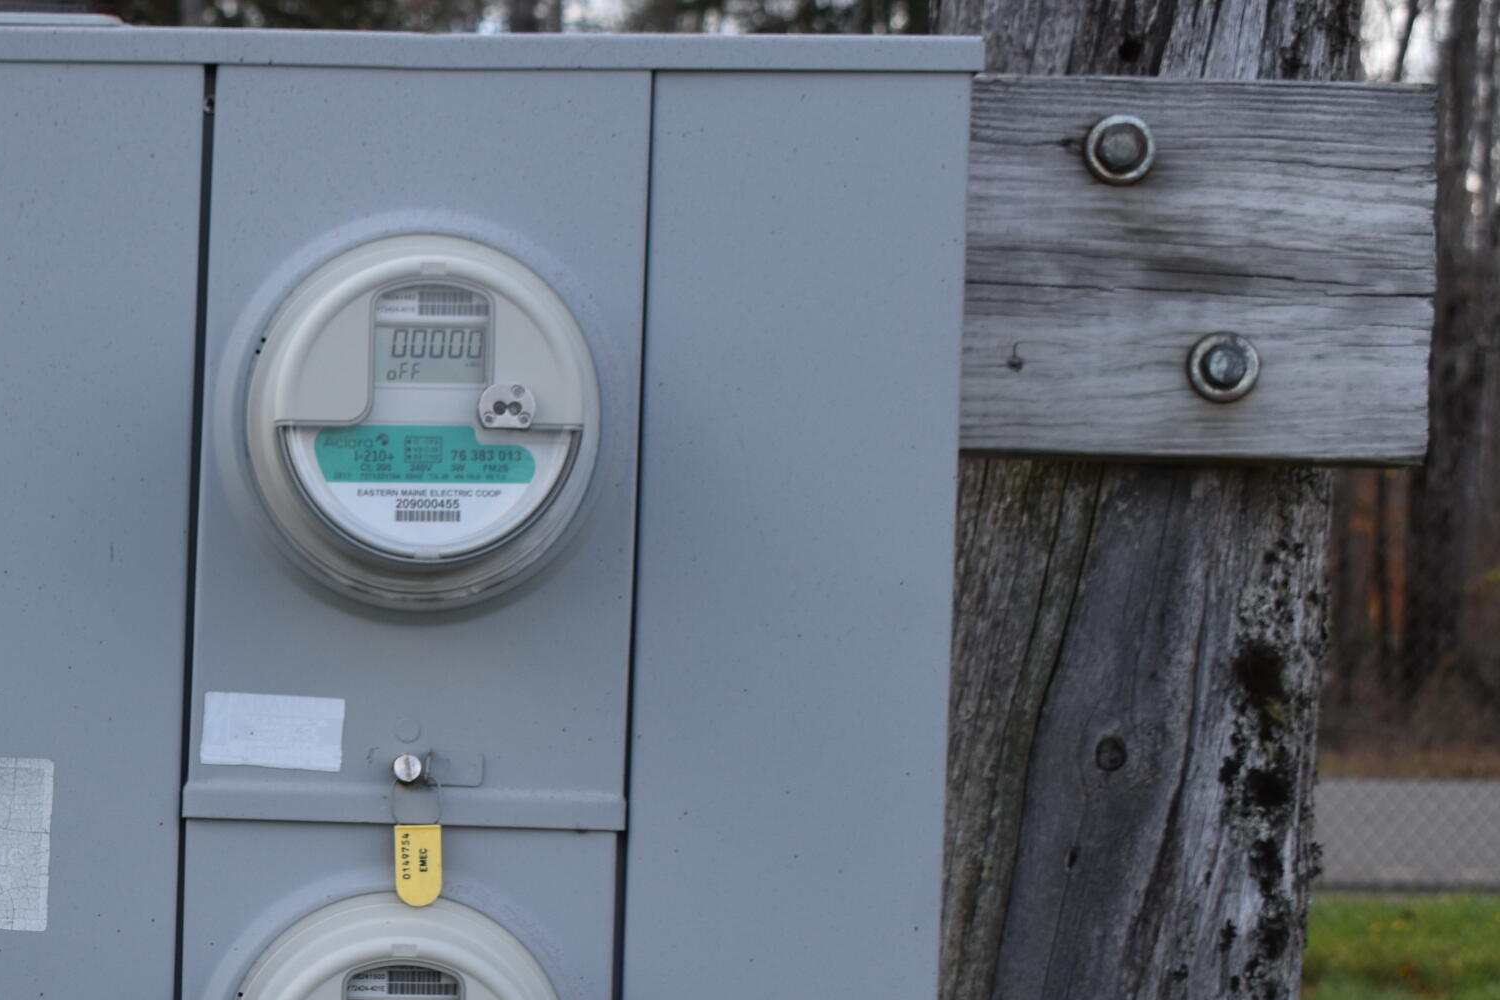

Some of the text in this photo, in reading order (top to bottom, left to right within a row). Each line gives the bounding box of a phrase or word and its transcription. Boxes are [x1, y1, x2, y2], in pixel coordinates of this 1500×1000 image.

[391, 329, 483, 359] 00000
[323, 434, 375, 449] Aclara
[354, 450, 395, 462] I-210+
[451, 450, 522, 462] 76 383 013
[357, 488, 503, 498] EASTERN MAINE ELECTRIC COOP
[395, 498, 460, 509] 209000455
[401, 833, 411, 880] 0149754
[419, 848, 429, 873] EMEC
